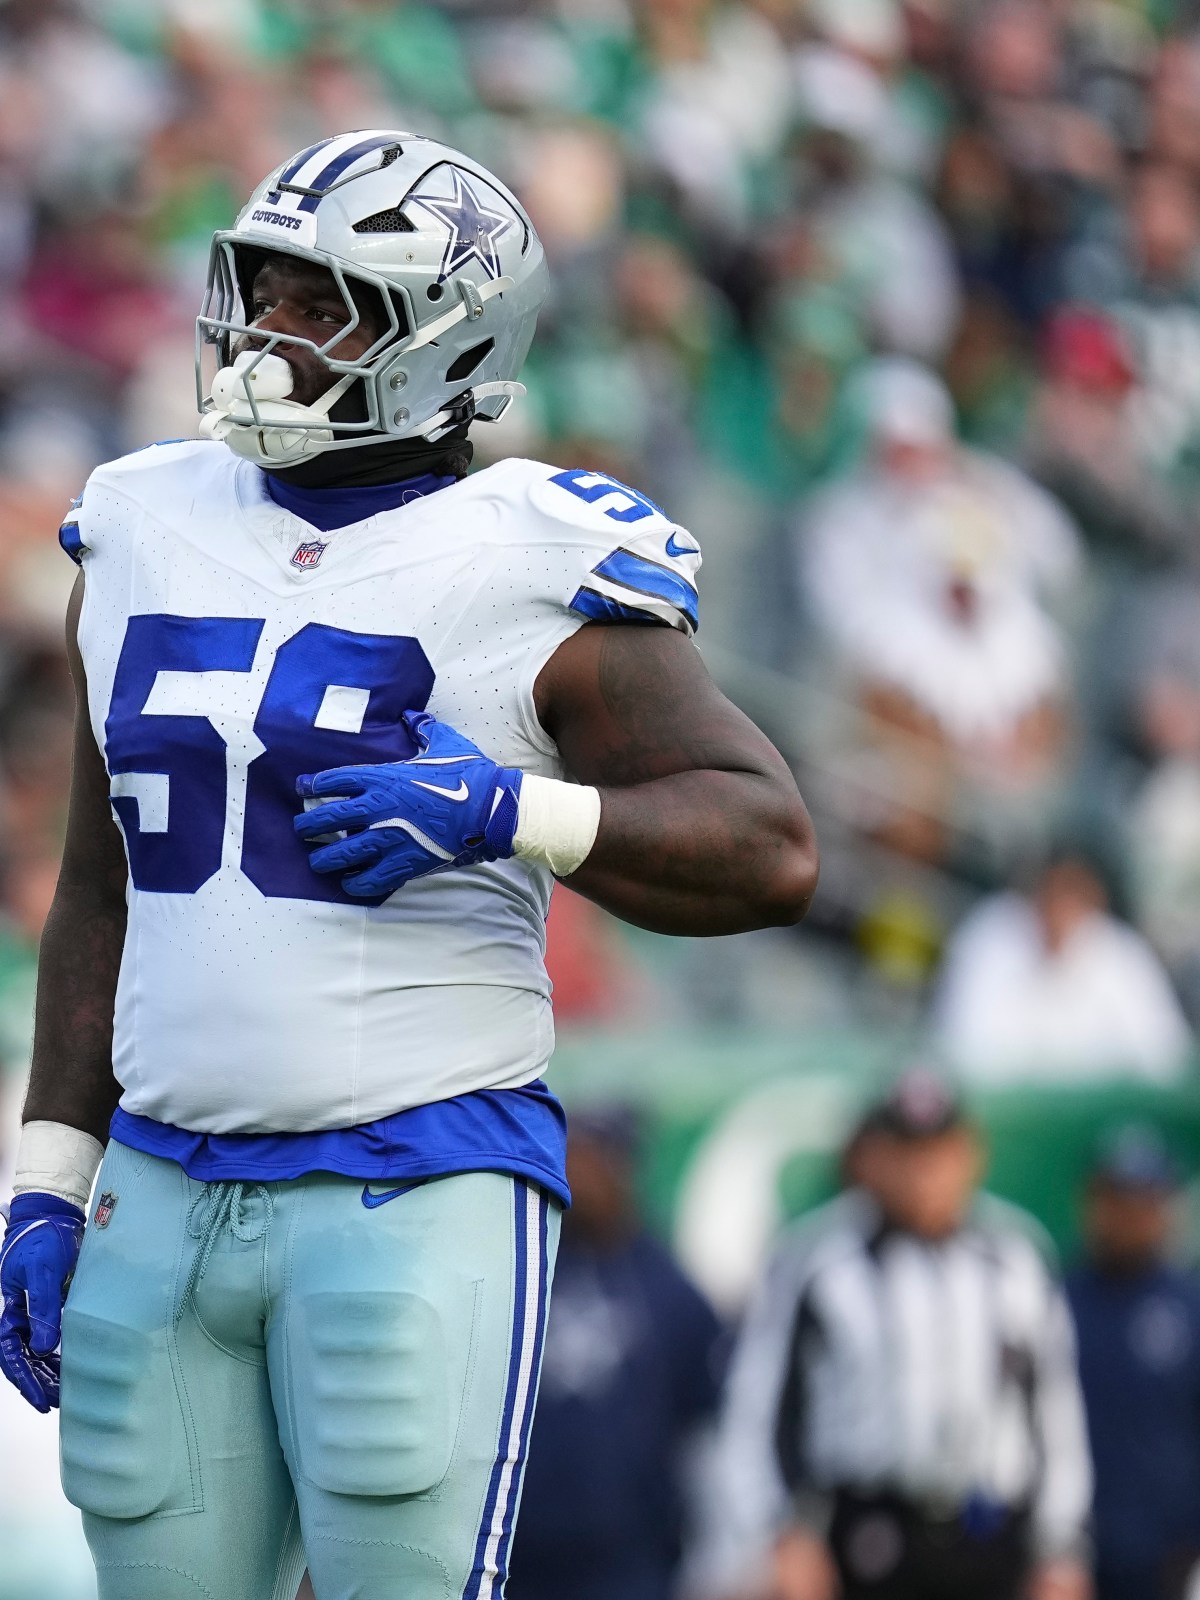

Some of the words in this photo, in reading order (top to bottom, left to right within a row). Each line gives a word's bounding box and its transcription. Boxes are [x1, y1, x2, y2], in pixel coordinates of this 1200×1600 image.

[252, 210, 302, 230] COWBOYS
[546, 468, 673, 523] 5
[295, 550, 317, 564] NFL
[104, 613, 436, 907] 58
